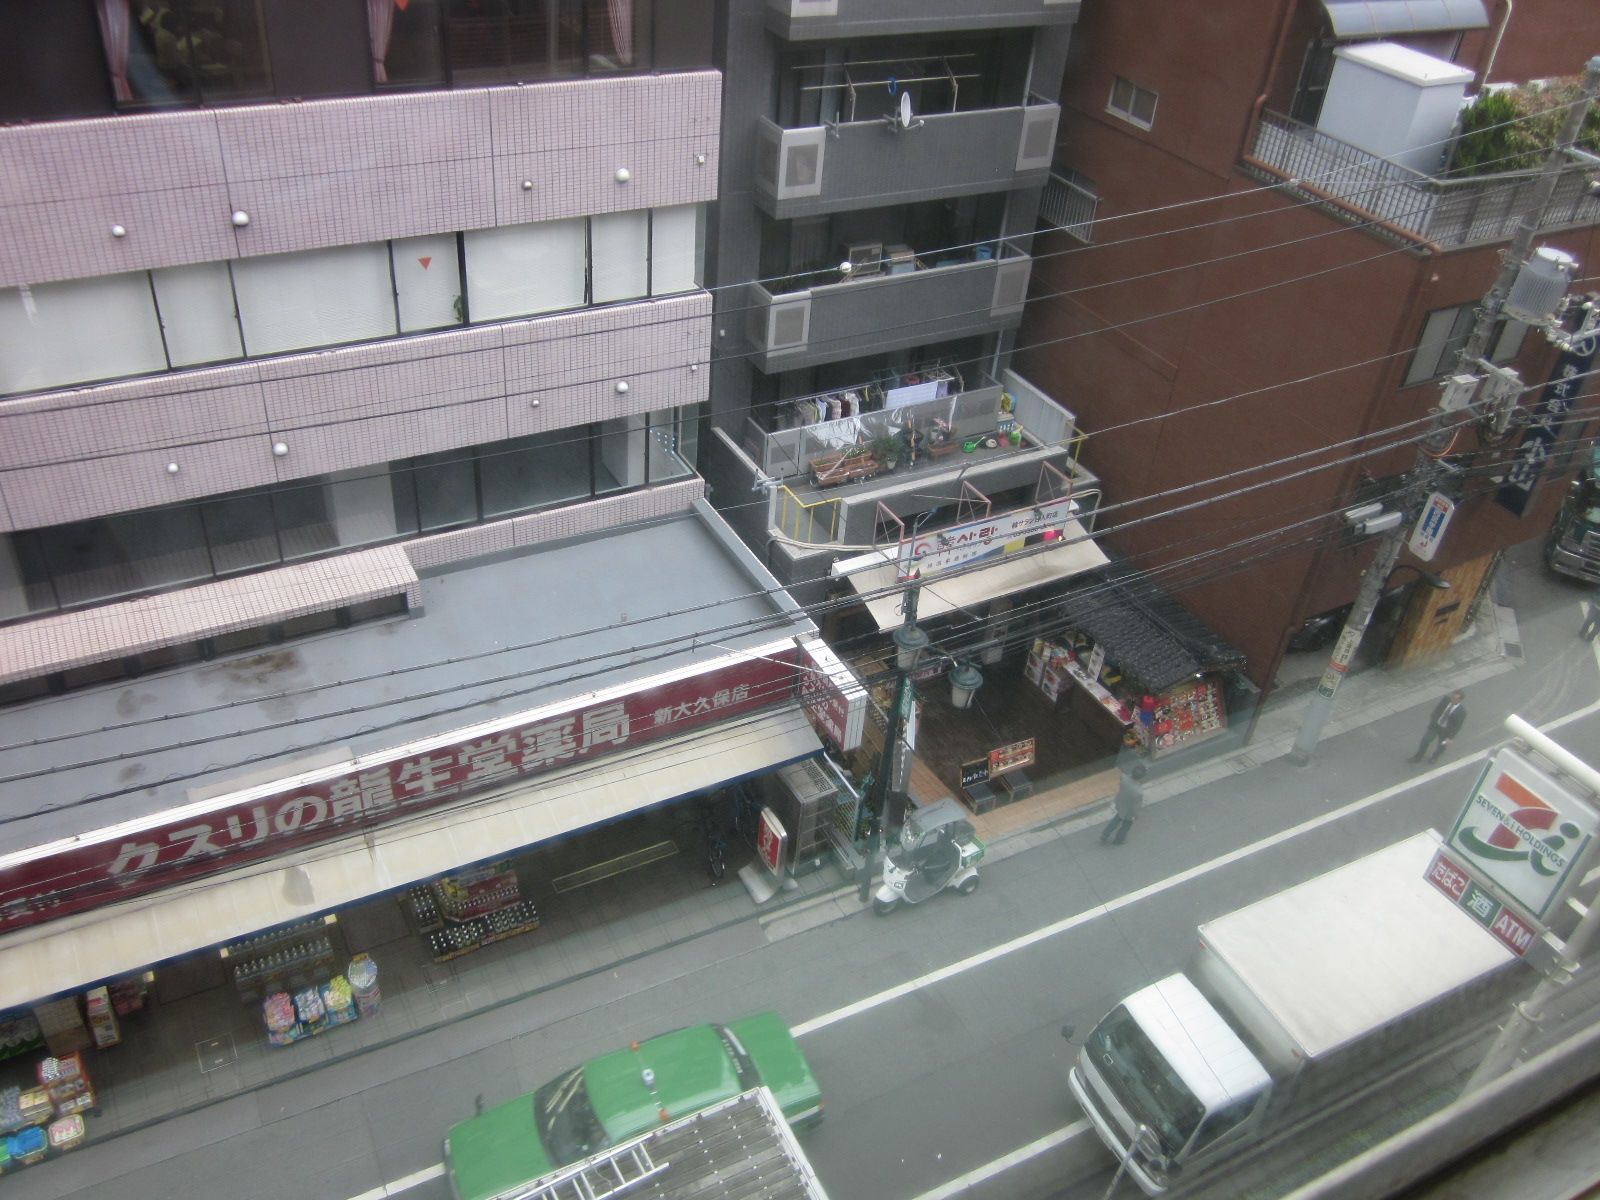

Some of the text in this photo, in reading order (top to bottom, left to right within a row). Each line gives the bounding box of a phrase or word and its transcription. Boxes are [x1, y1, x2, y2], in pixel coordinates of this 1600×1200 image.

[653, 683, 750, 725] 新大久保店
[1515, 826, 1567, 868] HOLDINGS
[1431, 861, 1532, 951] たばこ 酒 ATM
